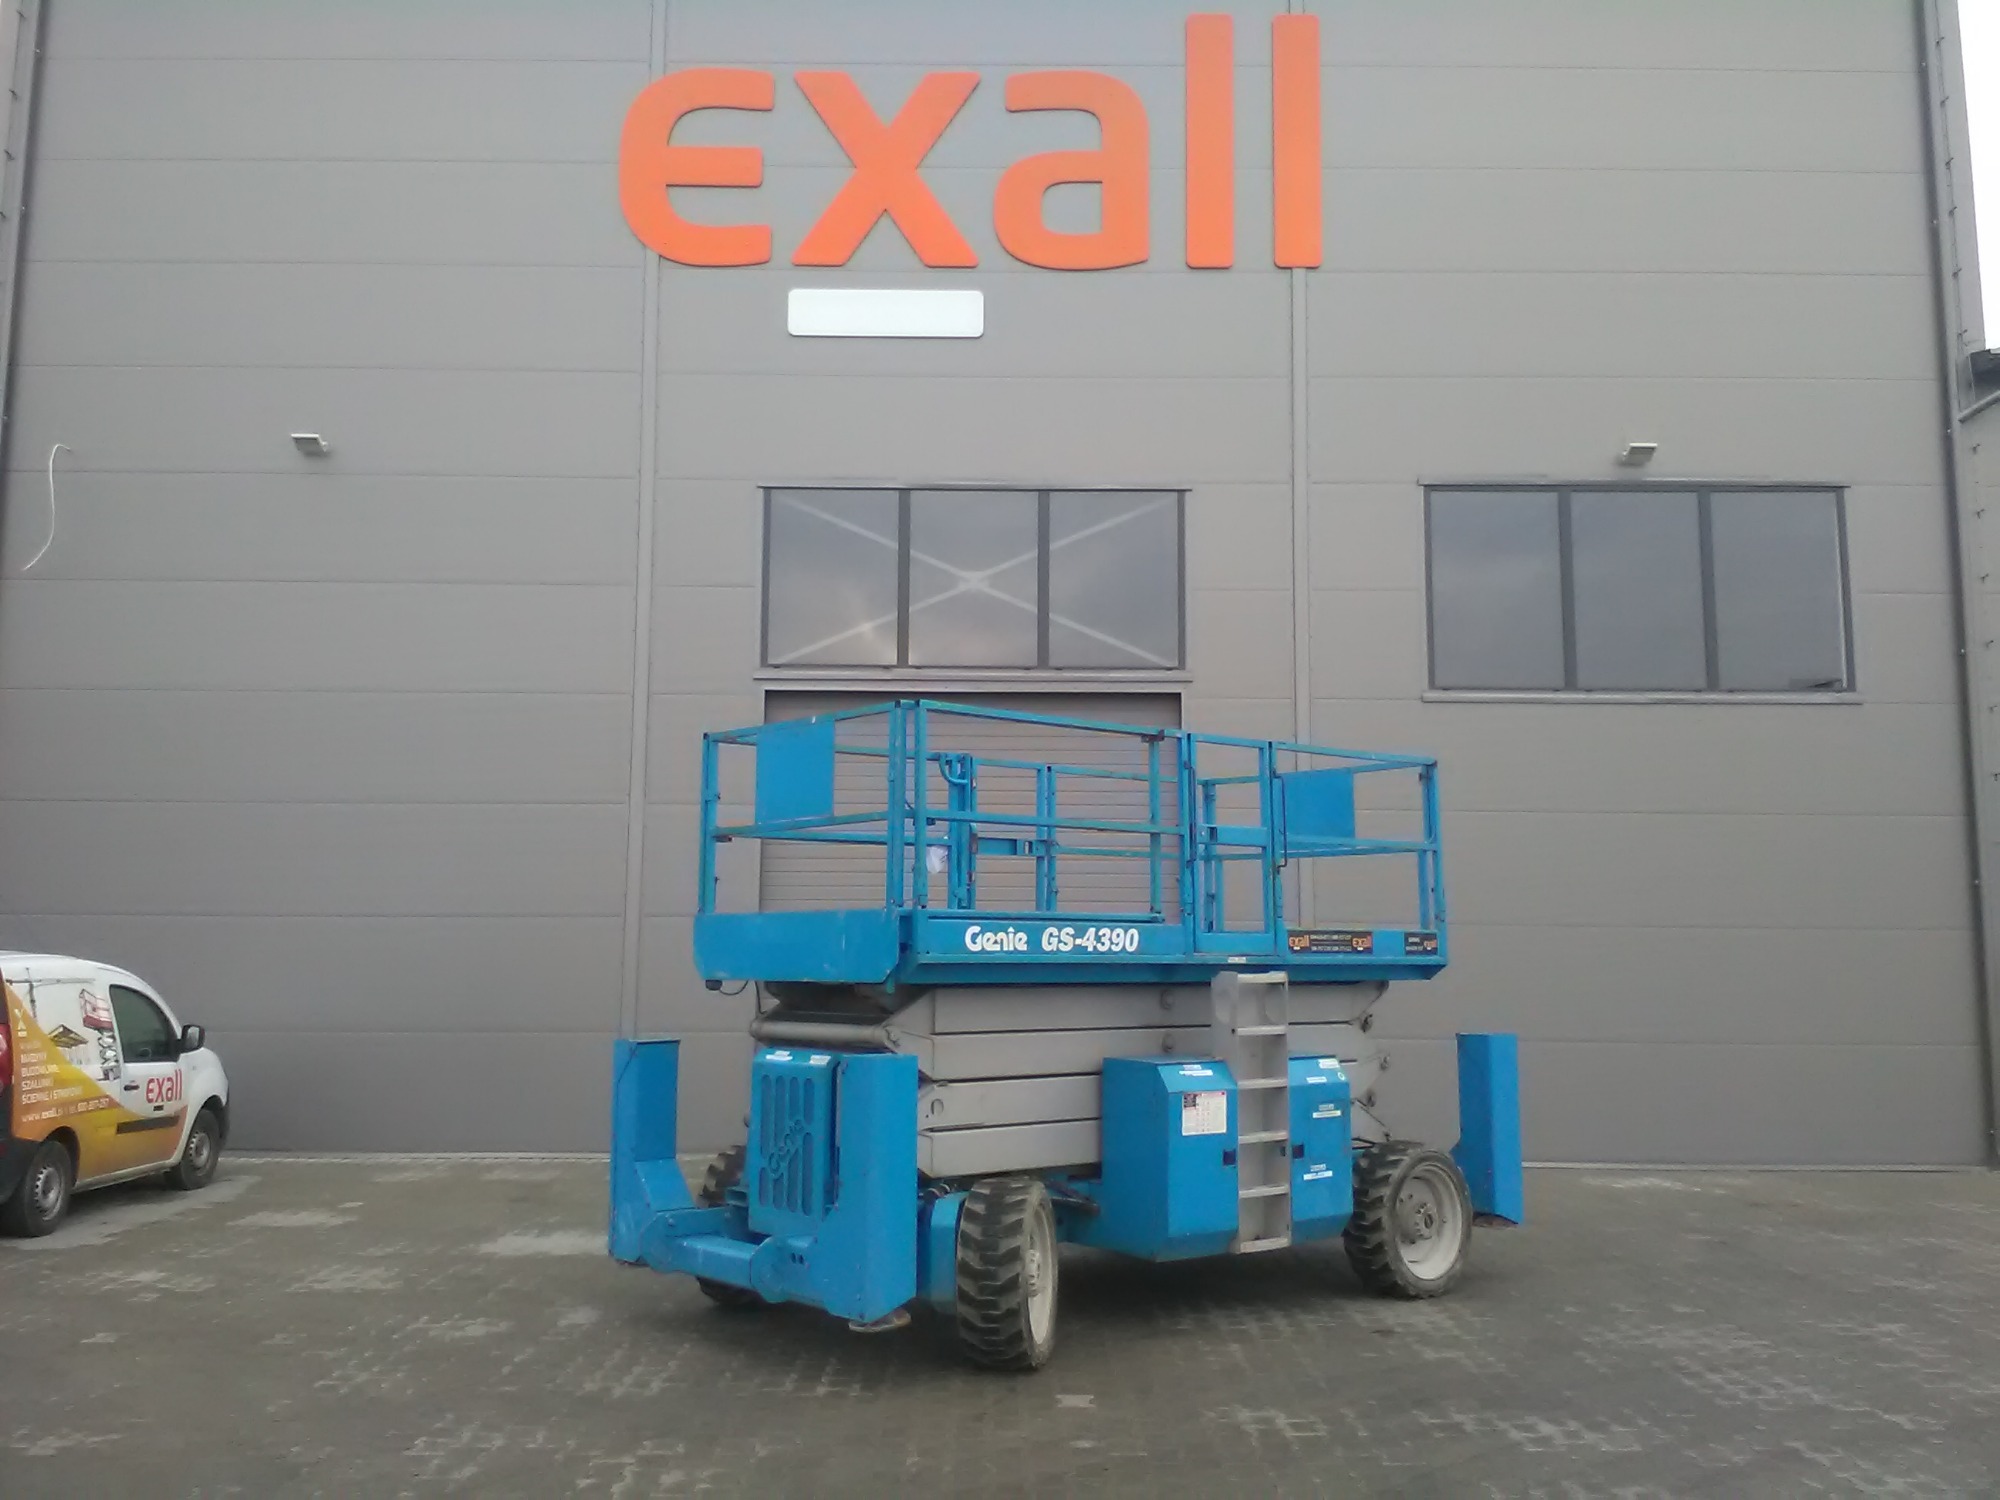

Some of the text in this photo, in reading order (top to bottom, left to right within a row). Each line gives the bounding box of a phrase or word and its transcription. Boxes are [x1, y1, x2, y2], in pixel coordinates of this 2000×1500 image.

[618, 13, 1323, 270] exall
[964, 925, 1140, 952] Genie GS-4390
[145, 1069, 183, 1104] exall
